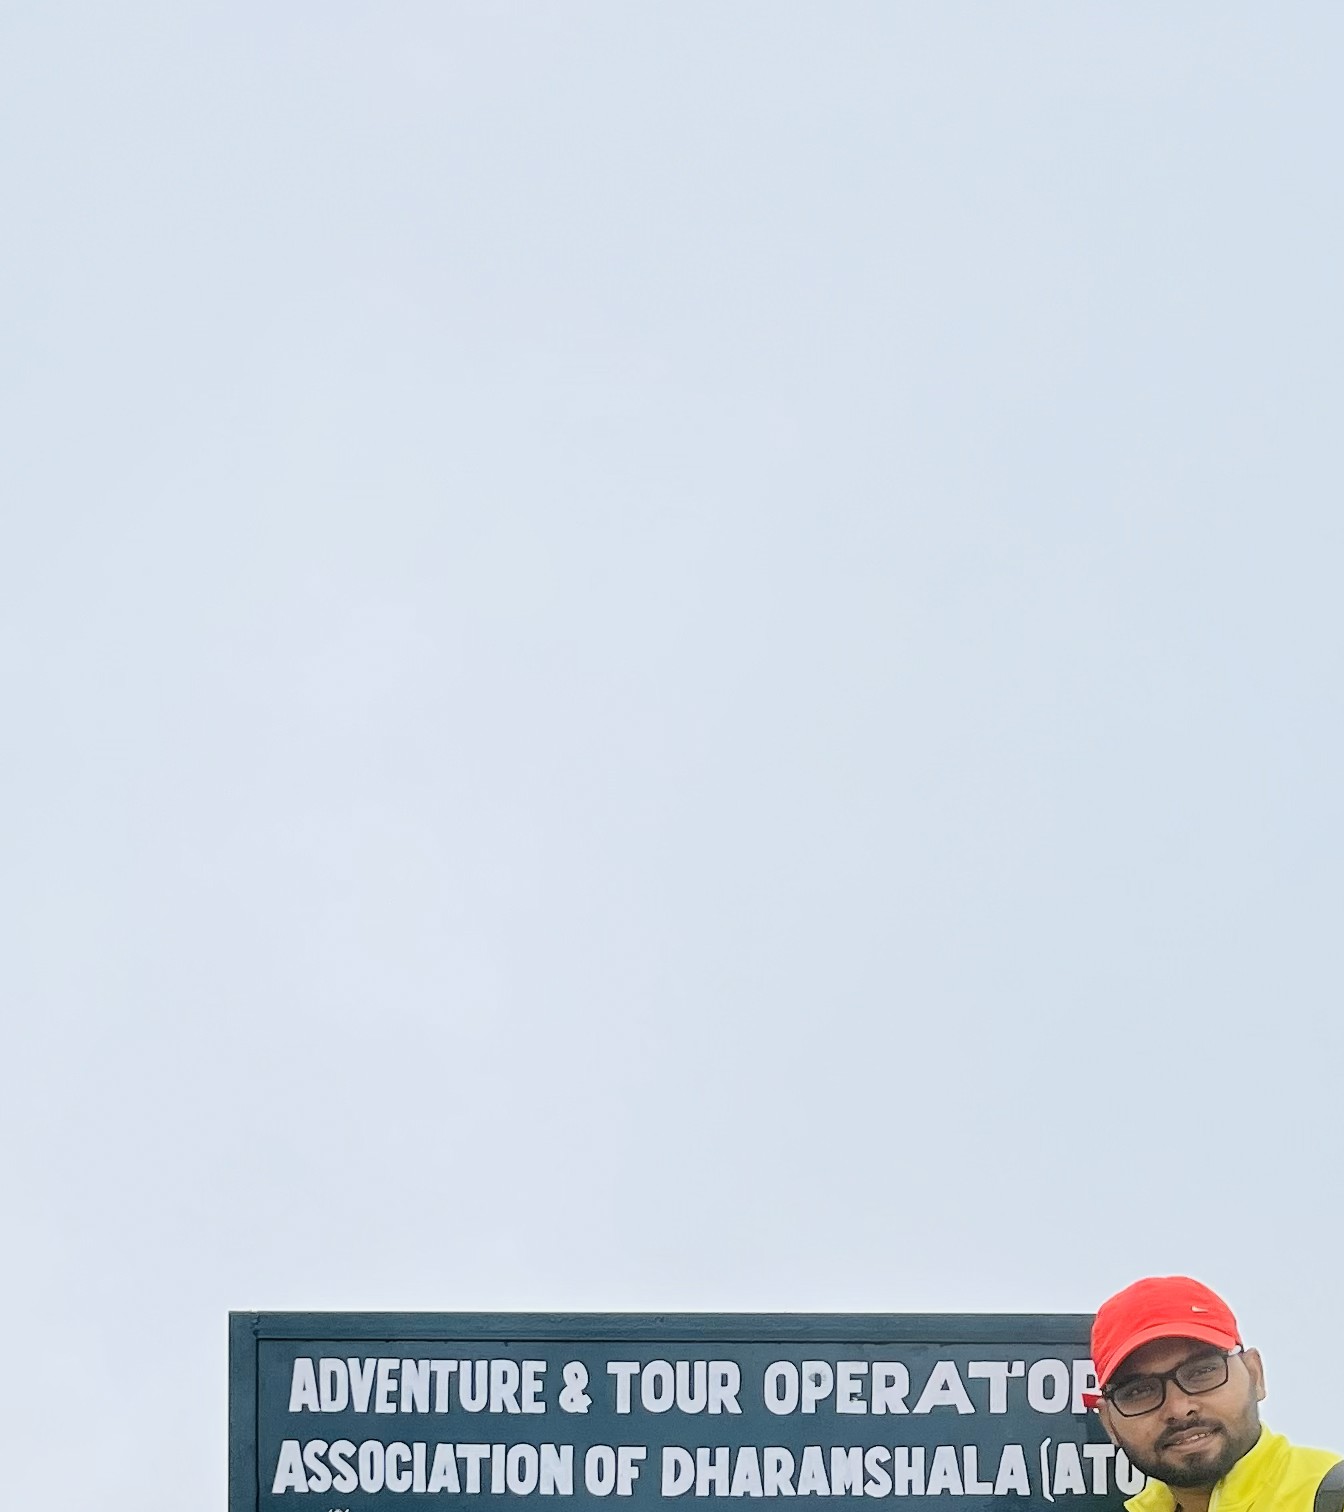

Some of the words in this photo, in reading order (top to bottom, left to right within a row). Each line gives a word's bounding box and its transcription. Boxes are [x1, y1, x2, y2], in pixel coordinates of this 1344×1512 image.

[288, 1357, 547, 1414] ADVENTURE
[558, 1361, 593, 1414] &
[606, 1360, 743, 1415] TOUR
[271, 1439, 574, 1496] ASSOCIATION
[584, 1445, 647, 1497] OF
[661, 1444, 1031, 1498] DHARAMSHALA
